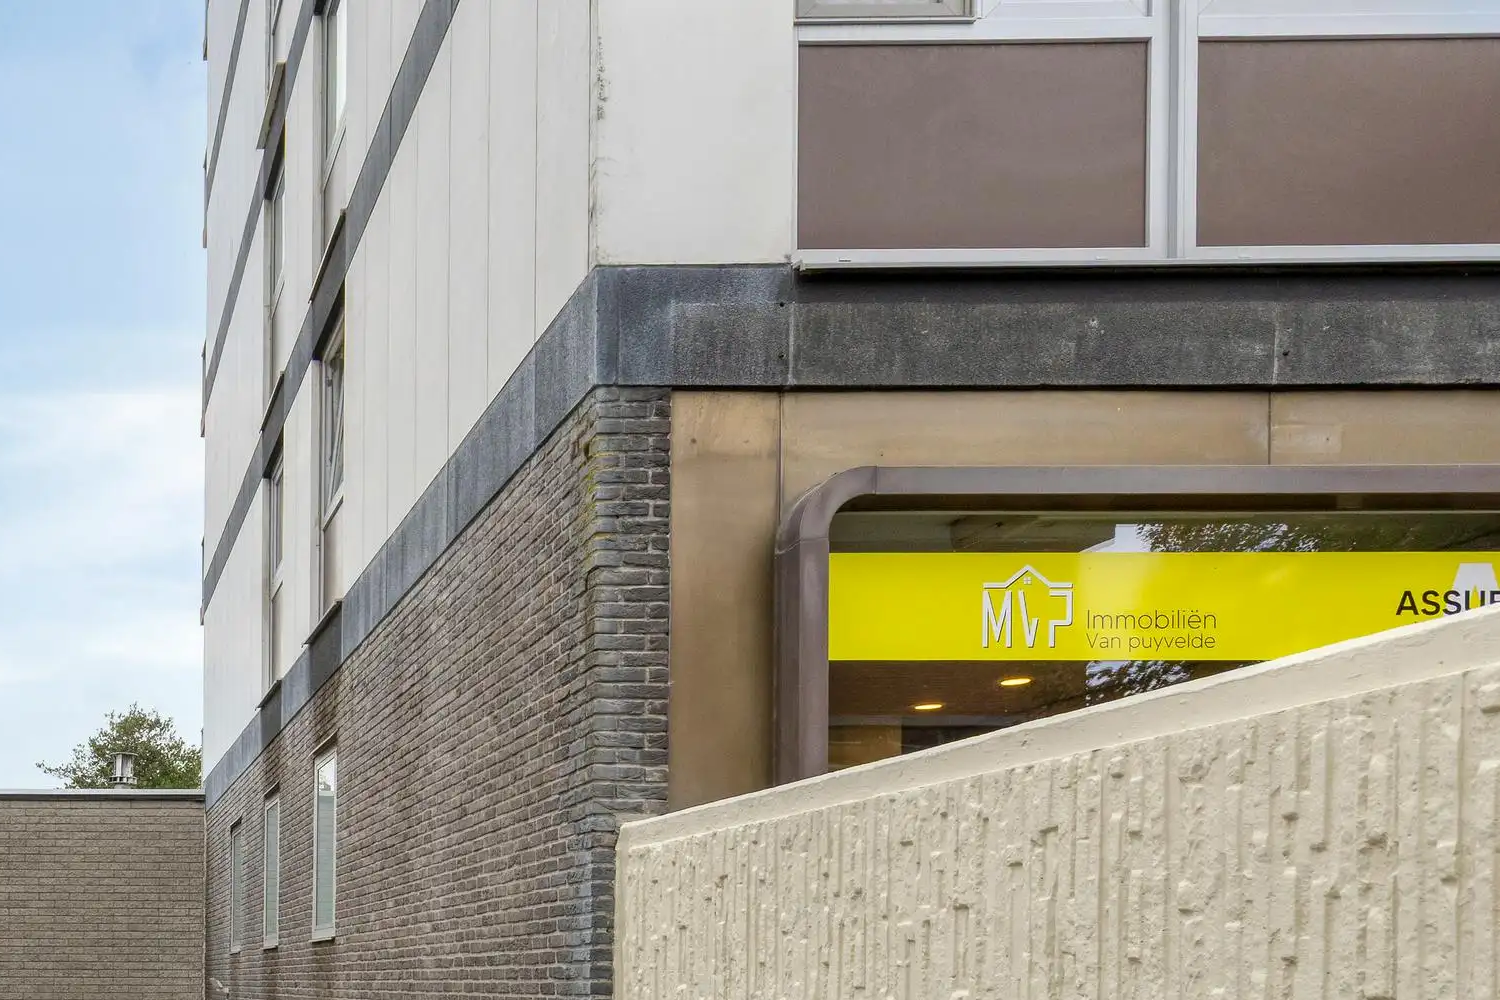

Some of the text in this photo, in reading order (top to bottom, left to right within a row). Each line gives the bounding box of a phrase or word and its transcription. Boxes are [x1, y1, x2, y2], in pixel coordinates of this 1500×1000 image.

[1086, 608, 1217, 630] Immobiliën
[1086, 632, 1217, 652] Van puyvelde
